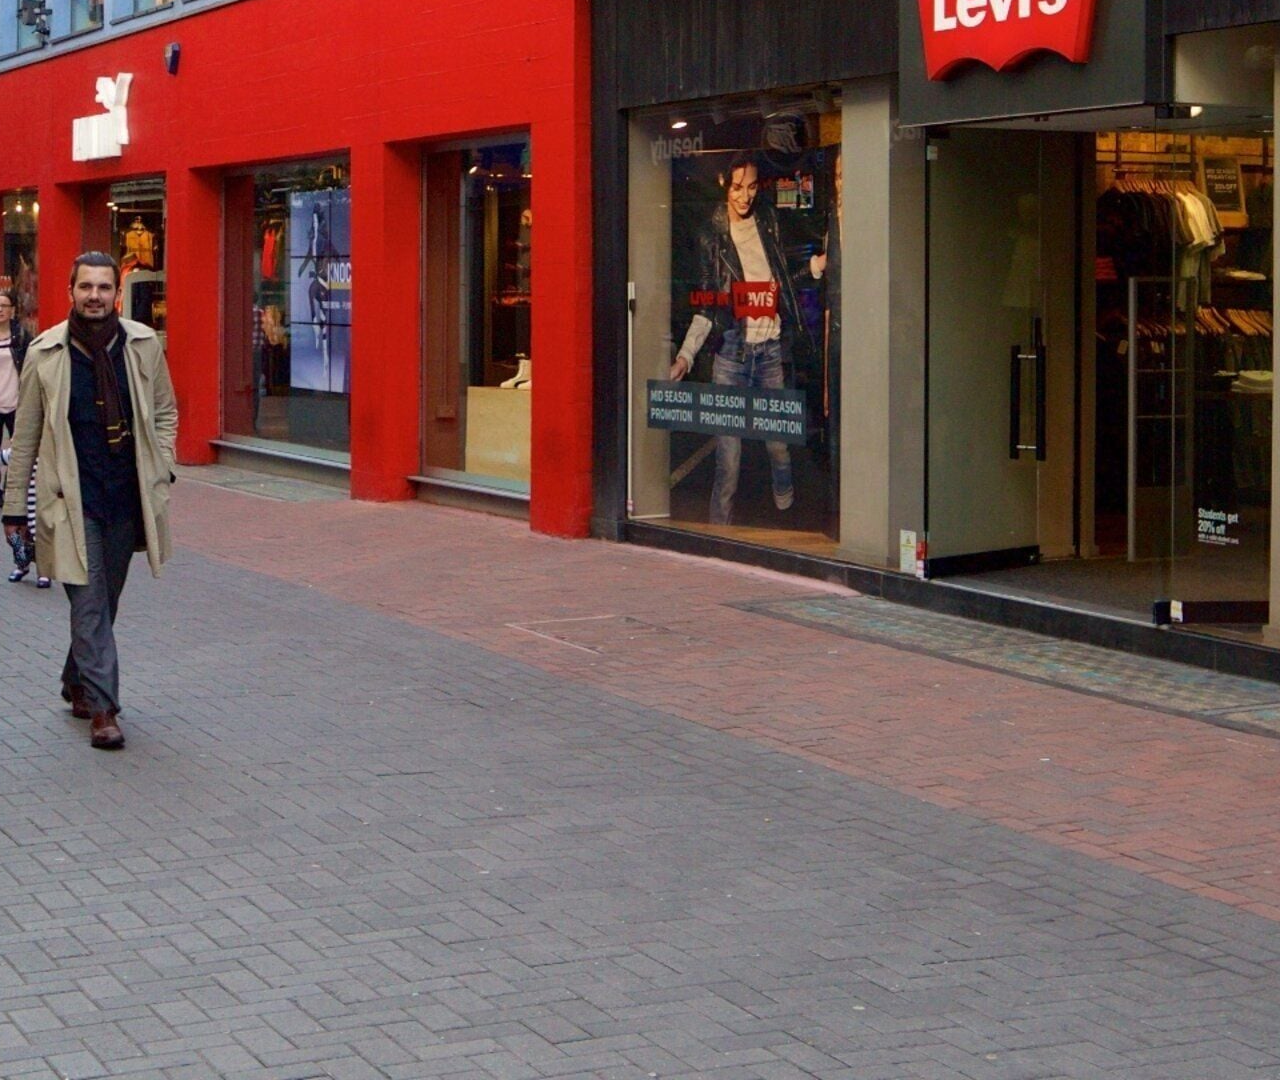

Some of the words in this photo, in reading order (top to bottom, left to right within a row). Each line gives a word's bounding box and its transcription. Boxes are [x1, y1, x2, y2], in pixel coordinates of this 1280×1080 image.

[650, 390, 663, 402] MID
[664, 391, 693, 404] SEASON
[700, 393, 714, 406] MID
[715, 396, 746, 409] SEASON
[753, 398, 767, 412] MID
[769, 400, 802, 415] SEASON
[650, 407, 693, 423] PROMOTION
[700, 411, 746, 429] PROMOTION
[753, 417, 802, 435] PROMOTION
